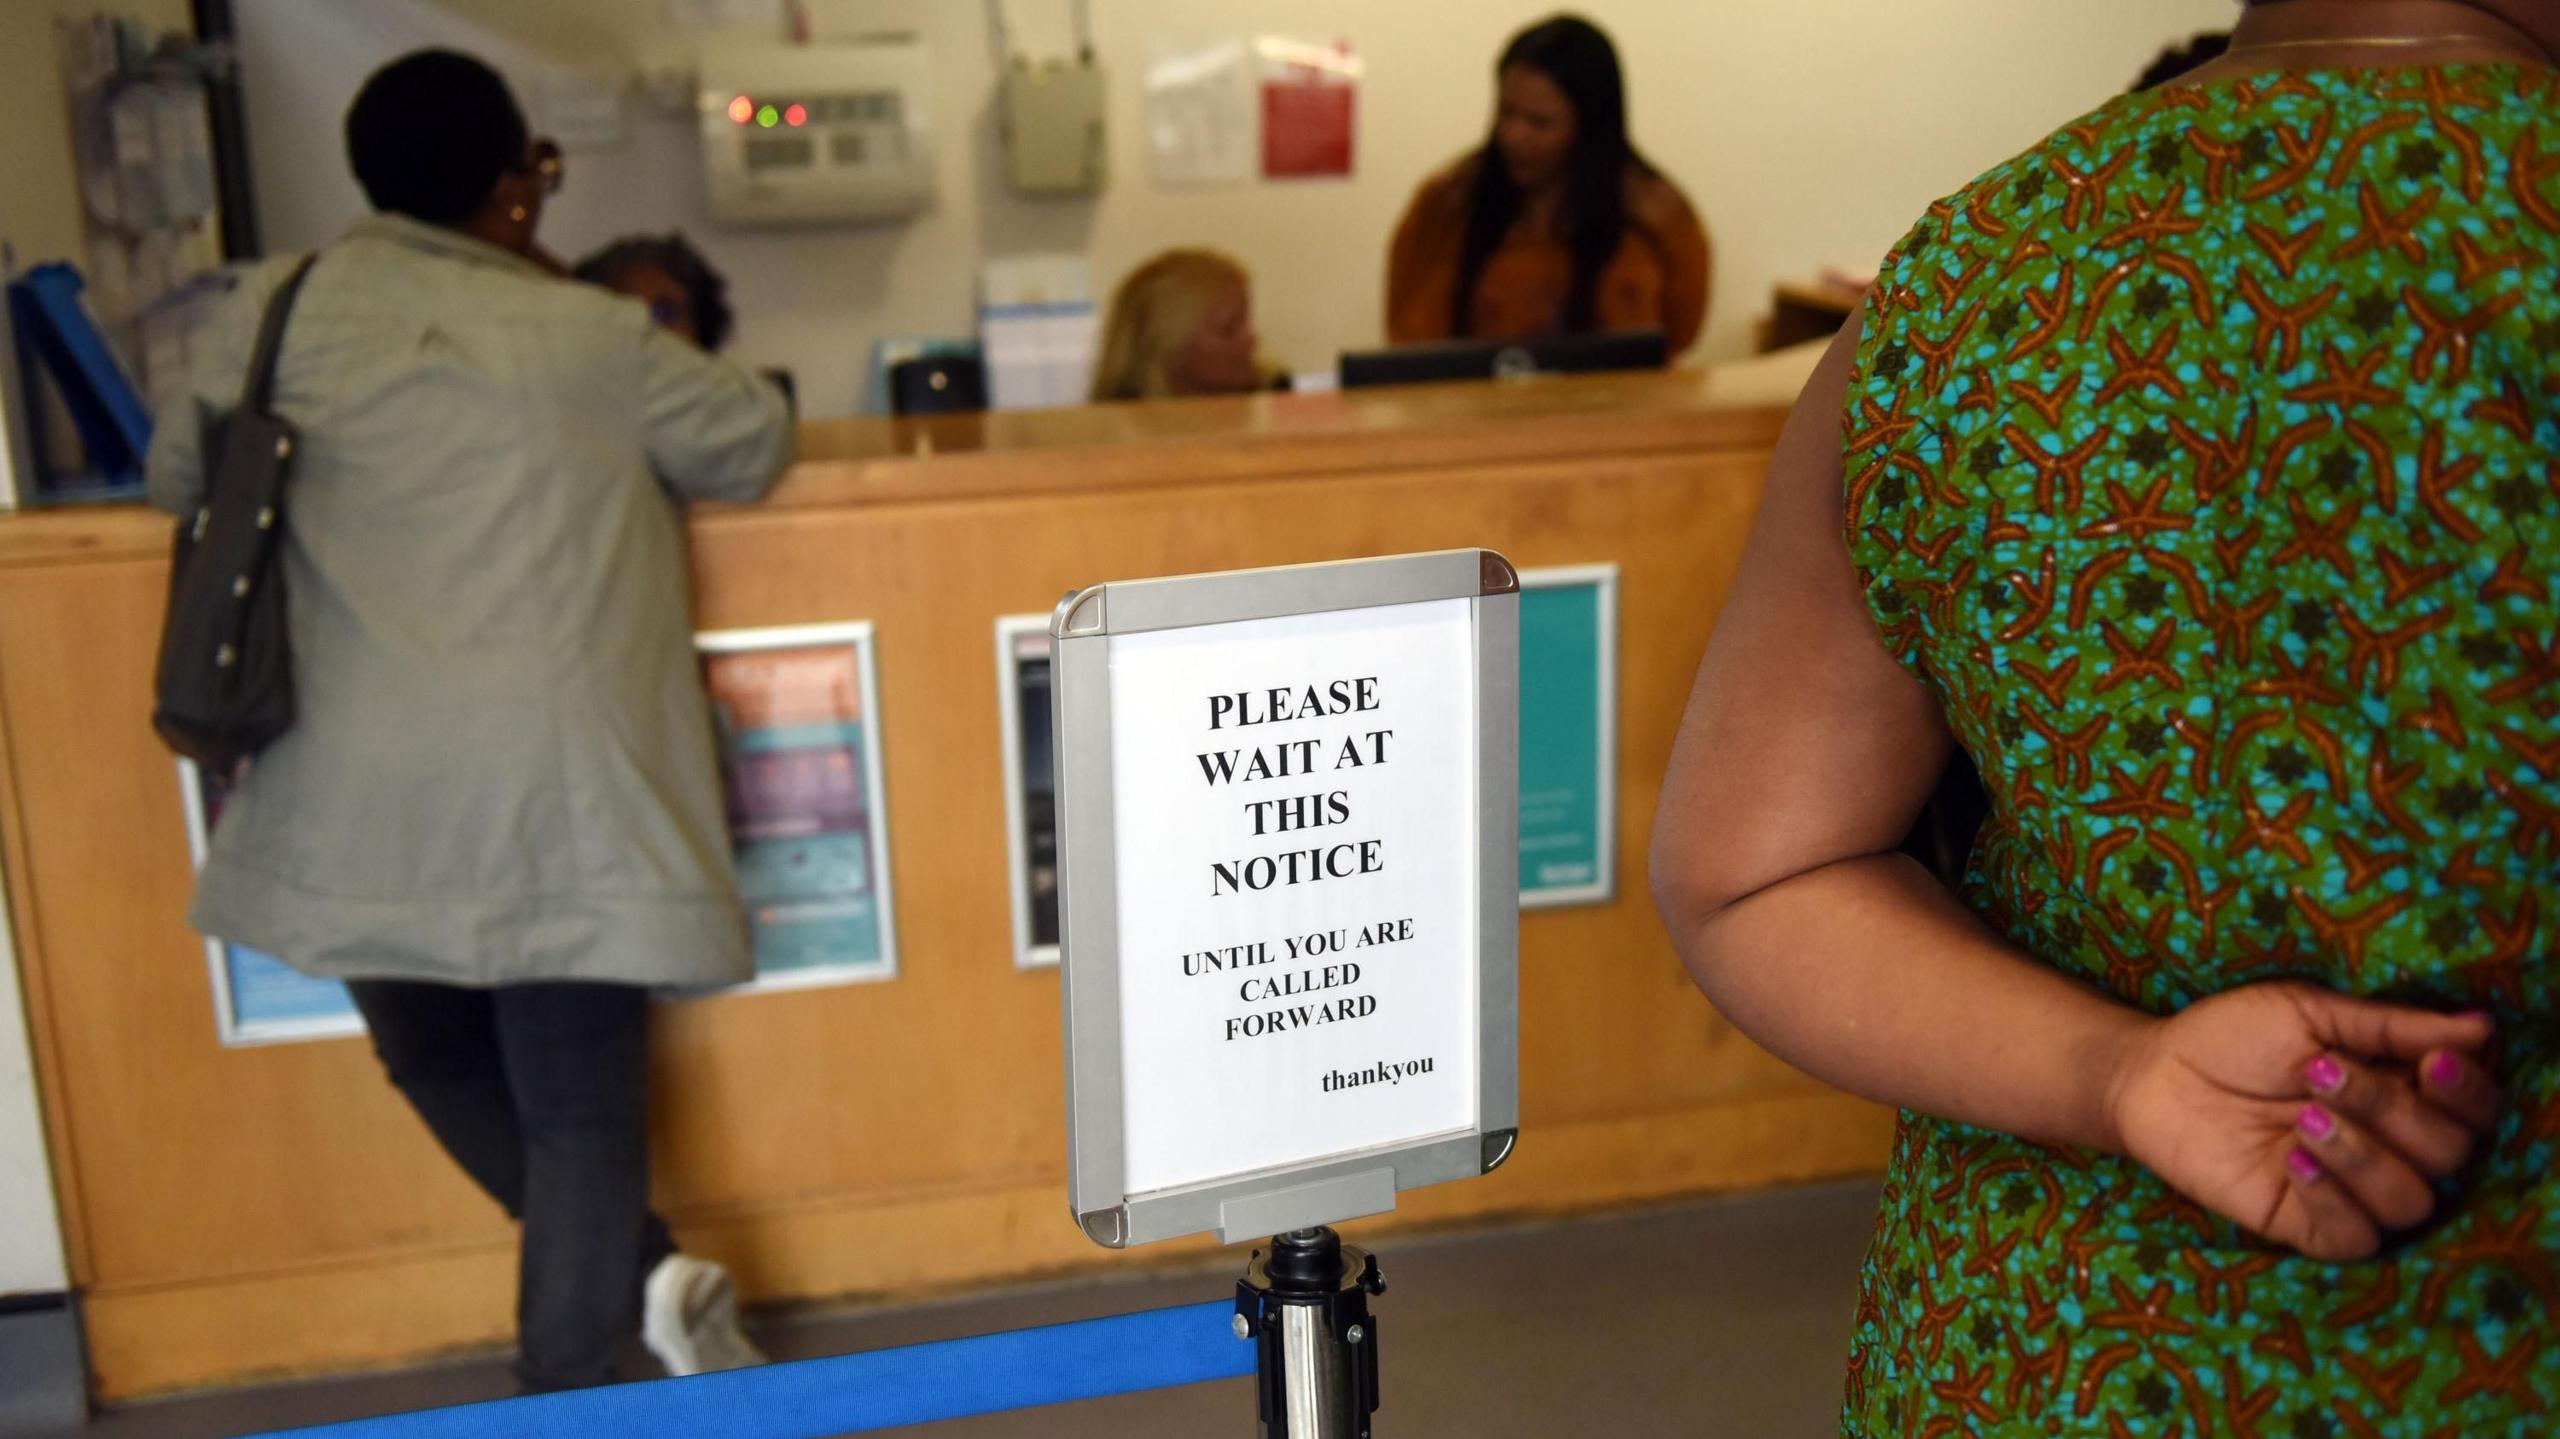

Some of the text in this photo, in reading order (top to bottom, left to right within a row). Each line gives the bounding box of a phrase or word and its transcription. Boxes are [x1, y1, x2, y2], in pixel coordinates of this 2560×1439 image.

[1208, 676, 1380, 730] PLEASE
[1197, 729, 1393, 787] WAIT AT
[1244, 790, 1350, 835] THIS
[1211, 839, 1384, 896] NOTICE
[1182, 918, 1415, 977] UNTIL YOU ARE
[1240, 963, 1361, 1002] CALLED
[1225, 994, 1377, 1041] FORWARD
[1321, 1056, 1435, 1093] thankyou
